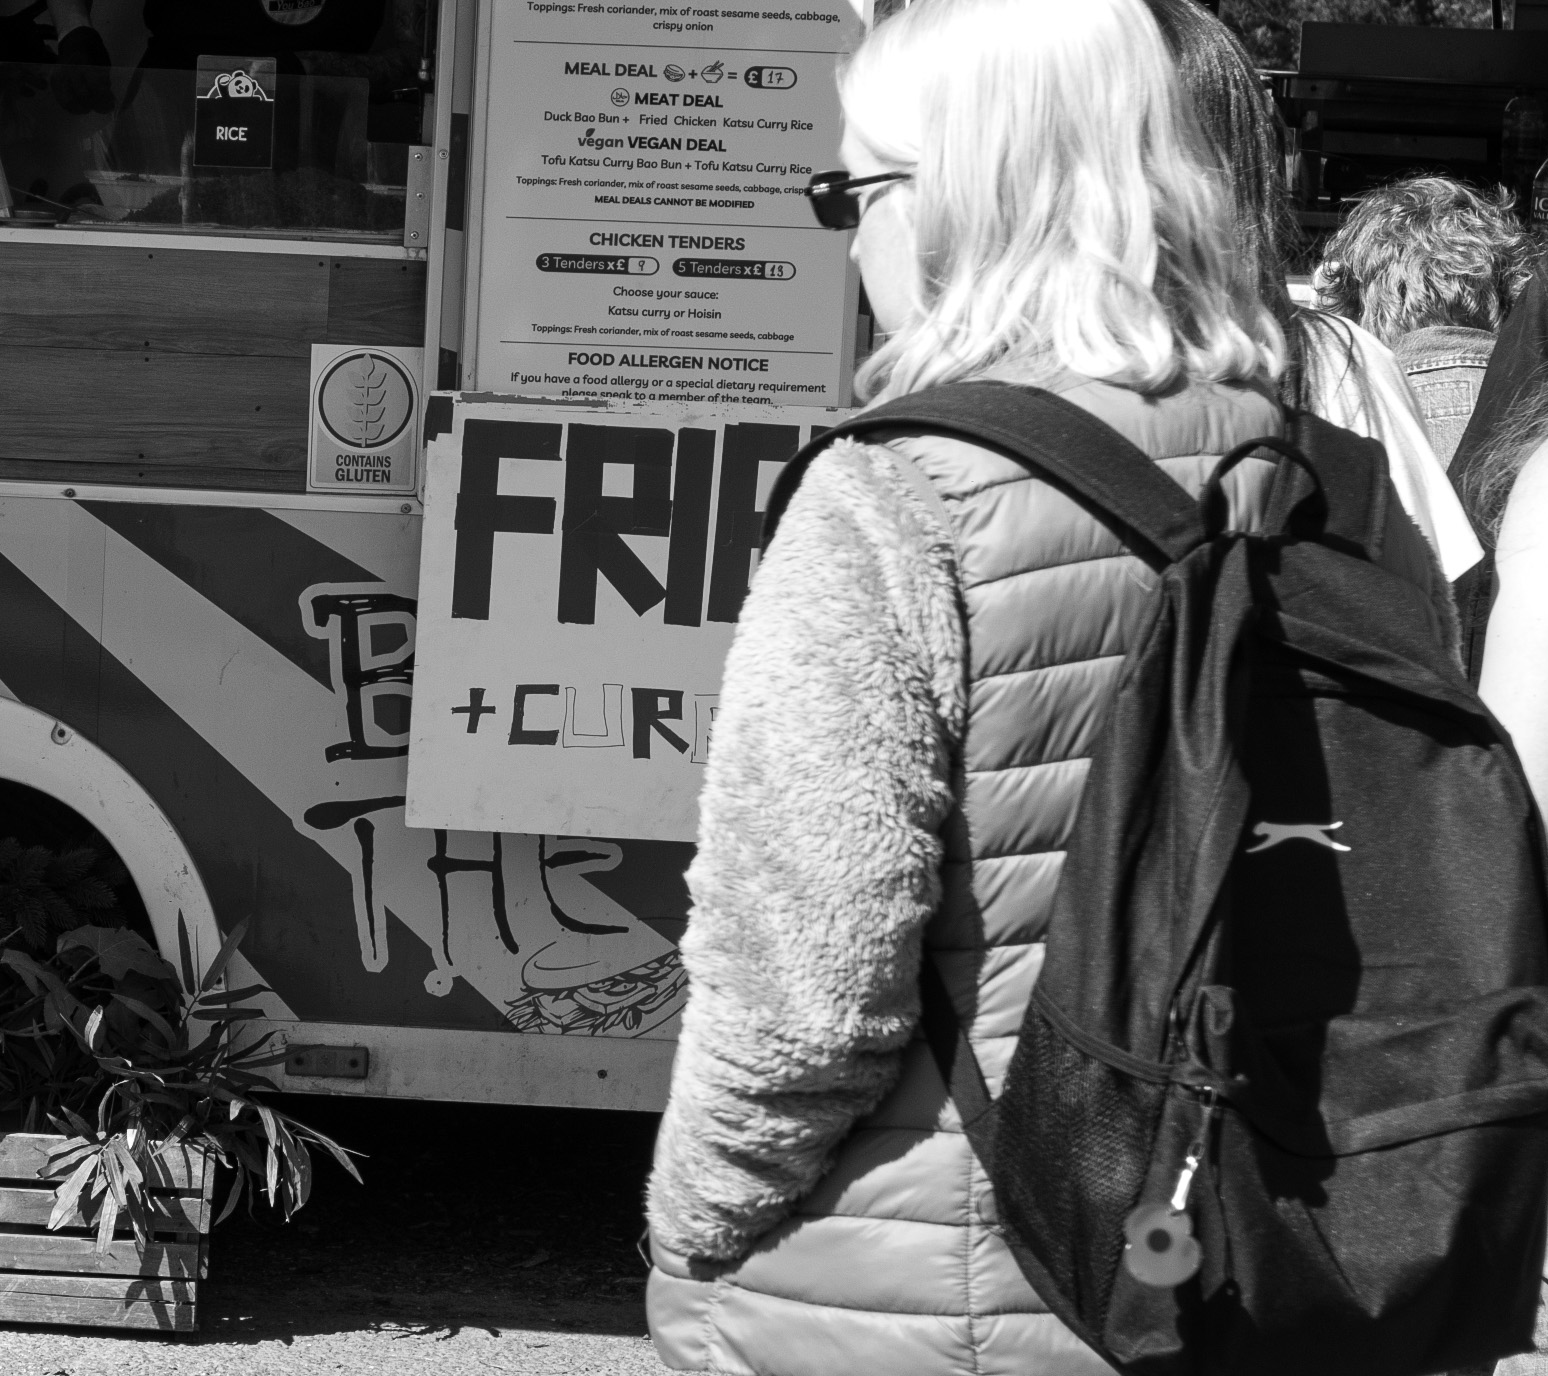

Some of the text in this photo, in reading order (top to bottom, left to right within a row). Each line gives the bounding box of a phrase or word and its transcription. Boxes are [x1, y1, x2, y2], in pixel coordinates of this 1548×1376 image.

[527, 1, 576, 14] Toppings:
[577, 3, 605, 13] Fresh
[607, 5, 657, 16] coriander,
[659, 6, 678, 15] mix
[680, 6, 692, 16] of
[692, 9, 719, 17] roast
[762, 10, 793, 21] seeds,
[795, 11, 840, 23] cabbage,
[653, 21, 713, 32] crispy onion
[564, 62, 611, 76] MEAL
[614, 63, 658, 78] DEAL
[748, 70, 759, 84] £
[767, 70, 784, 84] 17
[635, 92, 723, 108] MEAT DEAL
[215, 126, 248, 142] RICE
[577, 132, 727, 152] vegan VEGAN DEAL
[594, 195, 755, 208] MEAL DEALS CANNOT BE MODIFIED
[589, 233, 745, 250] CHICKEN TENDERS
[542, 257, 550, 268] 3
[553, 257, 605, 270] Tenders
[678, 261, 686, 272] 5
[690, 261, 742, 275] Tenders
[613, 286, 719, 300] Choose your sauce:
[608, 306, 721, 320] Katsu curry or Hoisin
[568, 352, 769, 372] FOOD ALLERGEN NOTICE
[511, 372, 520, 382] If
[521, 375, 541, 385] you
[544, 373, 571, 385] have
[582, 374, 608, 385] food
[610, 376, 649, 389] allergy
[651, 379, 664, 387] or
[675, 379, 714, 389] special
[716, 379, 755, 393] dietary
[758, 382, 826, 393] requirement
[335, 453, 392, 469] CONTAINS
[335, 468, 391, 484] GLUTEN
[451, 419, 848, 628] FRIE
